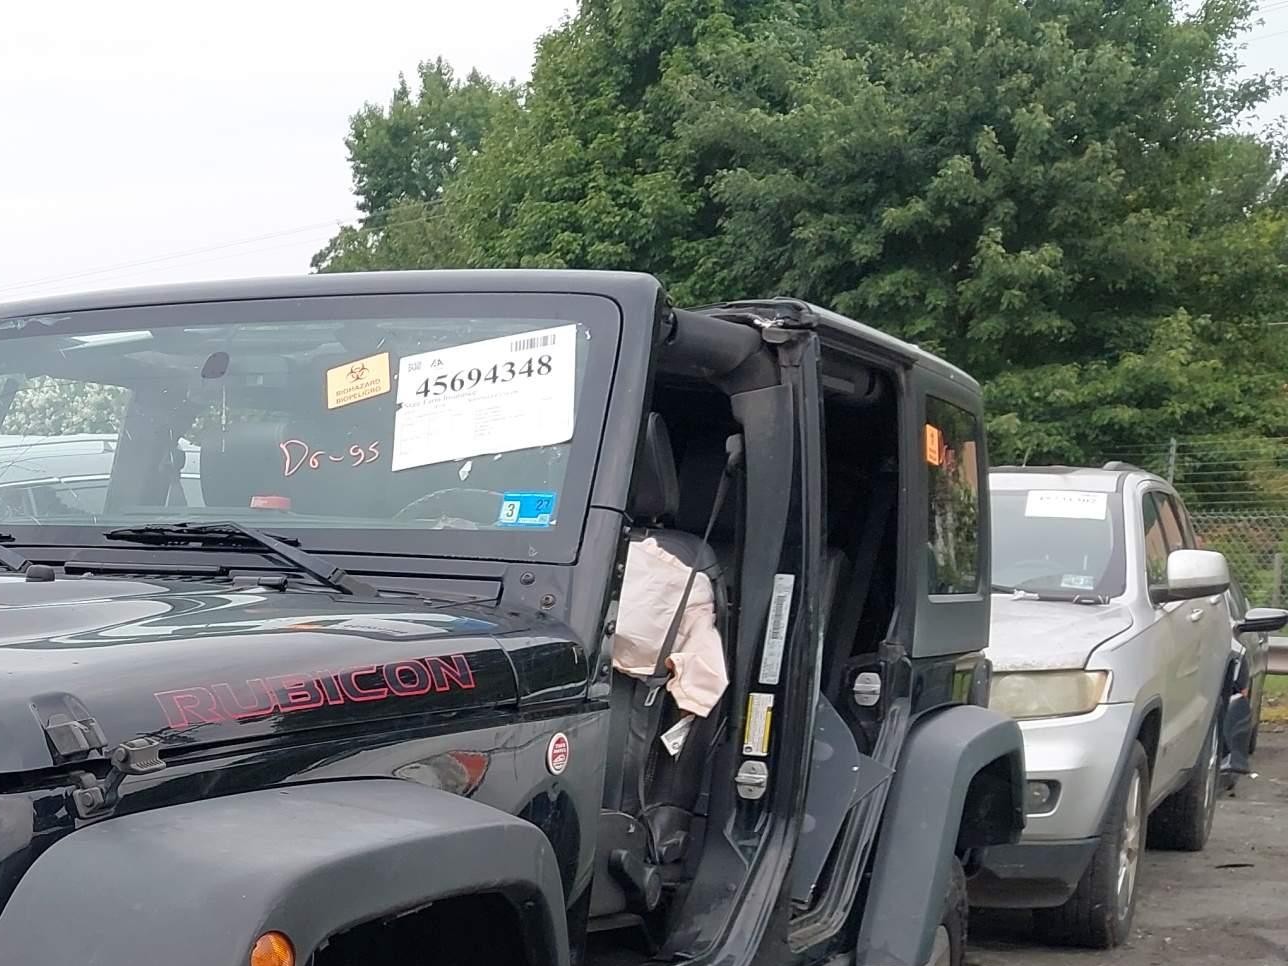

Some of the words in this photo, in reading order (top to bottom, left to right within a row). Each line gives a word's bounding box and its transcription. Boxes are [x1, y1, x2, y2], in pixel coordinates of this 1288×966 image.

[415, 354, 553, 398] 45694348
[335, 378, 381, 396] BIOHAZARD
[506, 503, 516, 518] 3
[536, 499, 551, 511] 27
[154, 655, 476, 729] RUBICON
